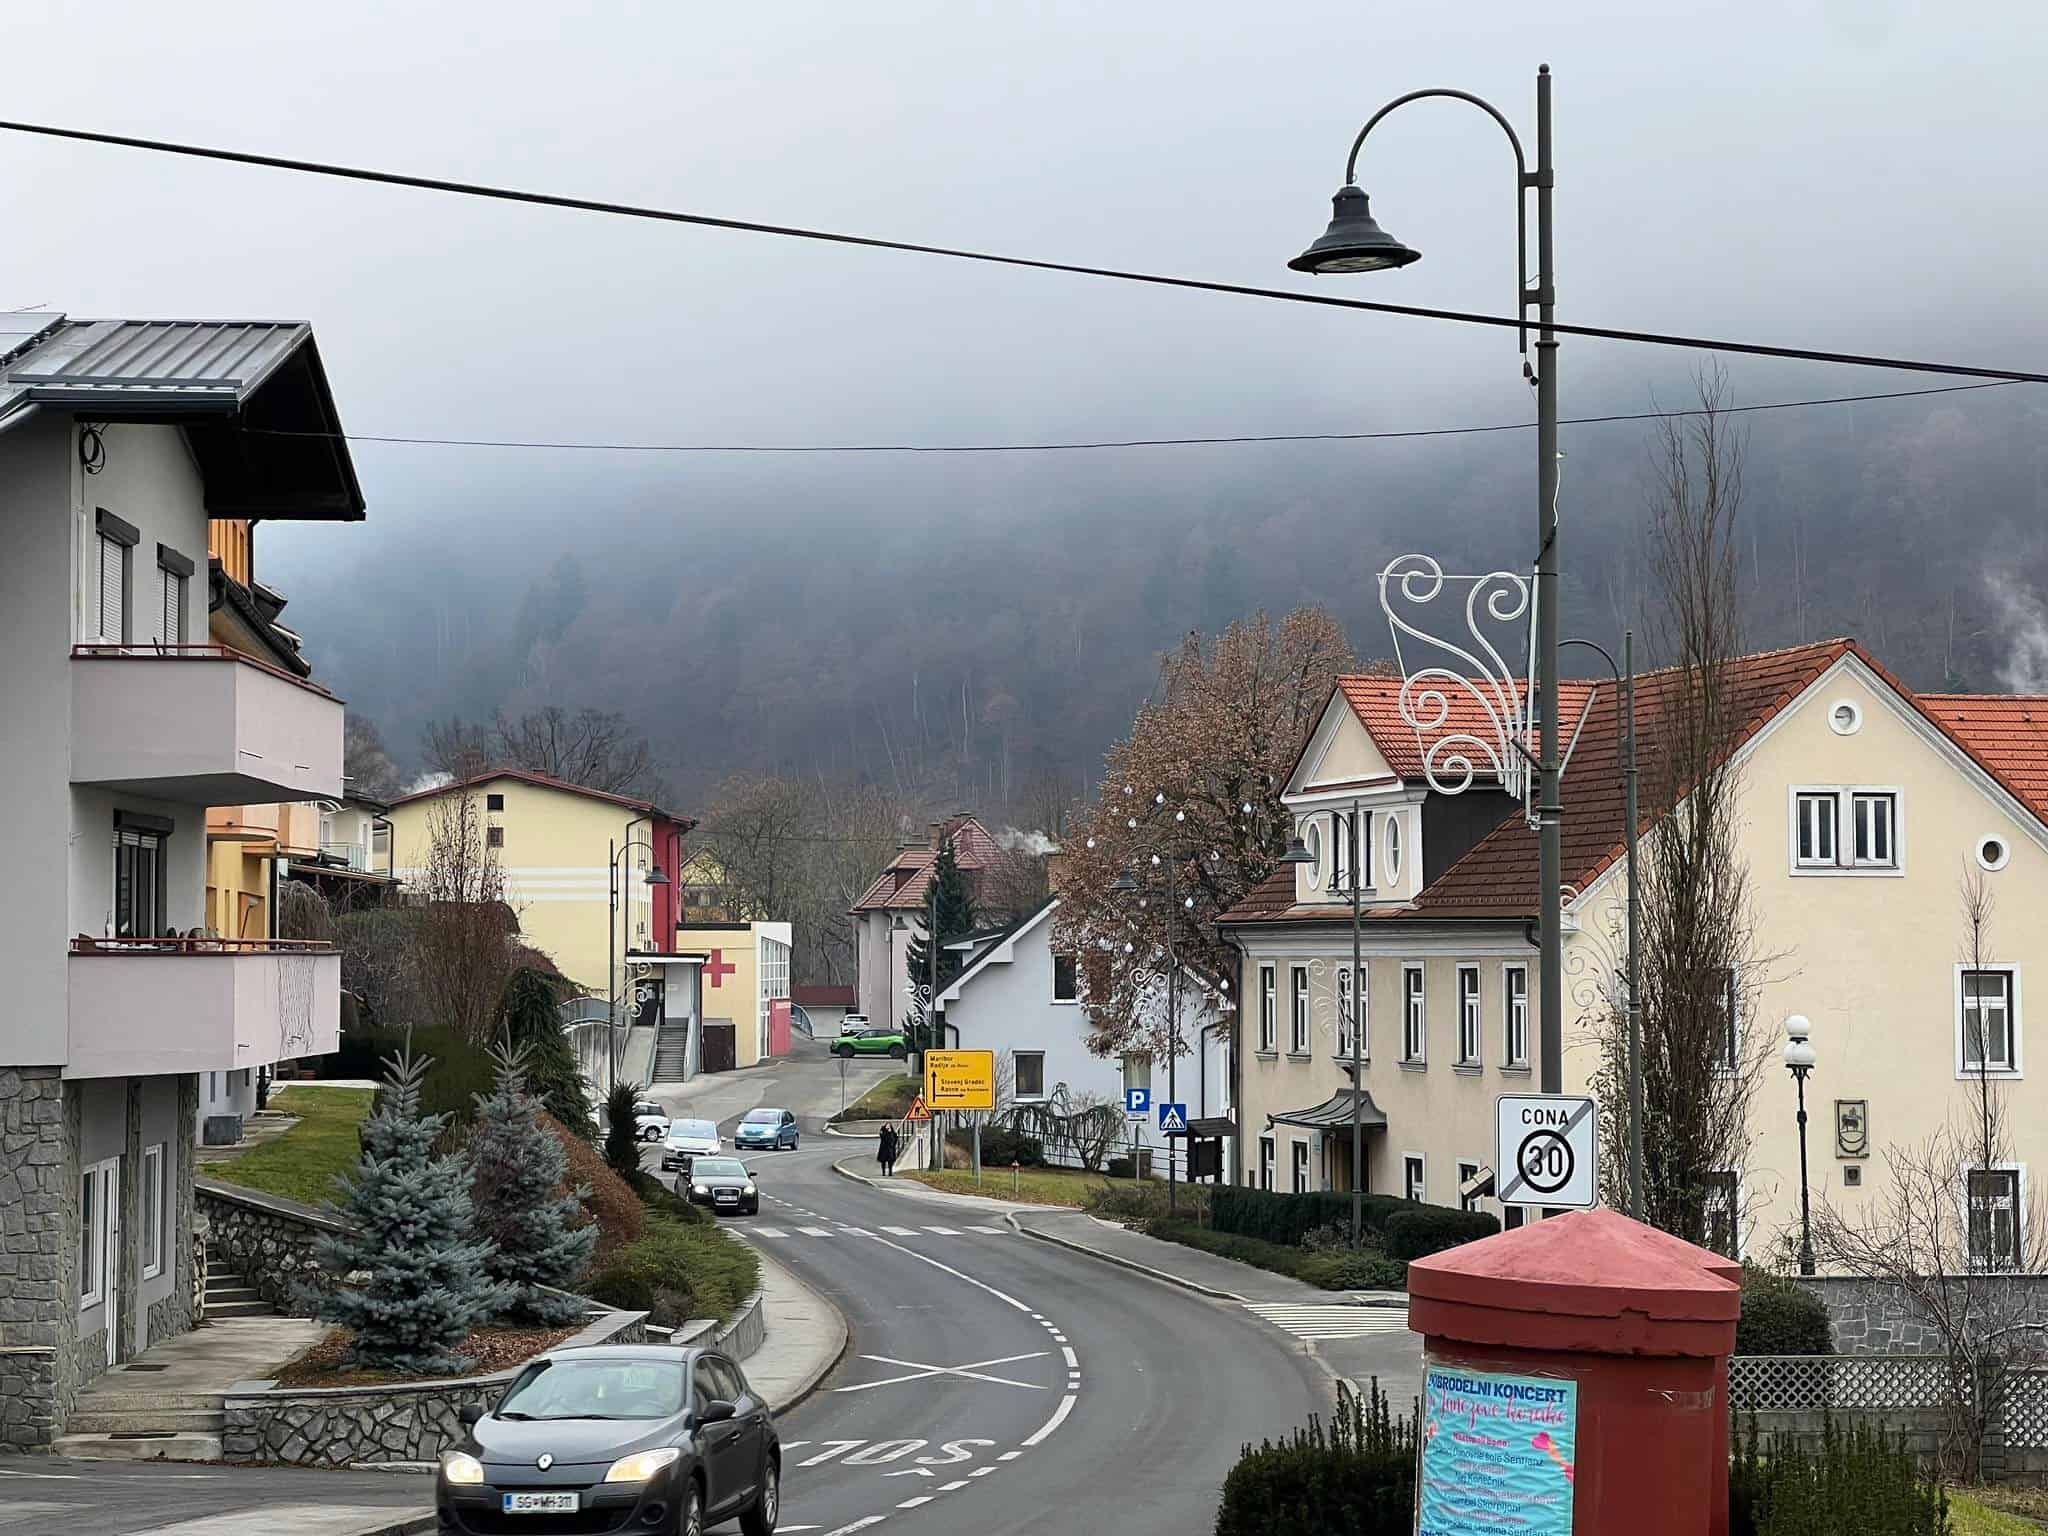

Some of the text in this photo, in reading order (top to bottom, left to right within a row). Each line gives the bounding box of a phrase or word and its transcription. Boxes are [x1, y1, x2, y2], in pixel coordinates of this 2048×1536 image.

[1131, 1091, 1145, 1109] P
[1522, 1108, 1569, 1125] CONA
[1529, 1145, 1563, 1177] 30
[1493, 1383, 1567, 1402] KONCERT
